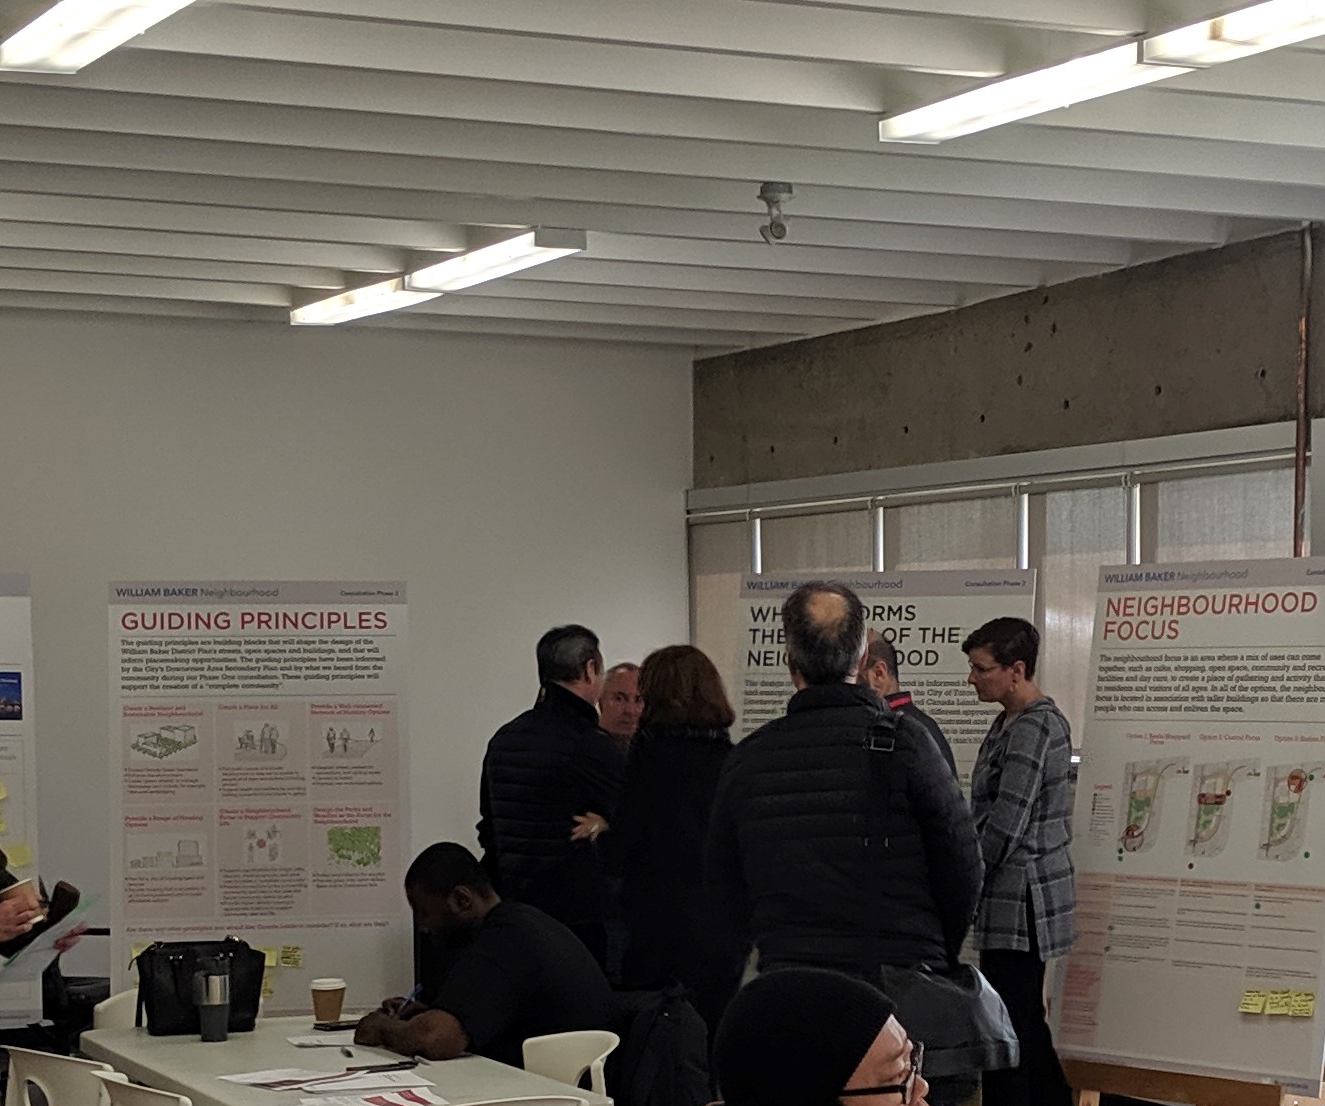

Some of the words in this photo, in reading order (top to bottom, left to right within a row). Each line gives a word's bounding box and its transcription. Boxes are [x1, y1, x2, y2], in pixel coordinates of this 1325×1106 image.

[1104, 573, 1144, 583] WILLIAM
[1144, 571, 1175, 582] BAKER
[746, 581, 789, 591] WILLIAM
[116, 588, 161, 597] WILLIAM
[163, 588, 198, 597] BAKER
[200, 588, 279, 598] Neighbourhood
[1105, 591, 1318, 617] NEIGHBOURHOOD
[121, 611, 231, 630] GUIDING
[241, 611, 387, 630] PRINCIPLES
[882, 627, 911, 644] OF
[918, 627, 960, 643] THE
[1103, 619, 1179, 641] FOCUS
[749, 628, 786, 645] THE
[1099, 654, 1111, 662] The
[926, 679, 960, 687] informed
[927, 689, 943, 698] City
[926, 698, 954, 706] Canada
